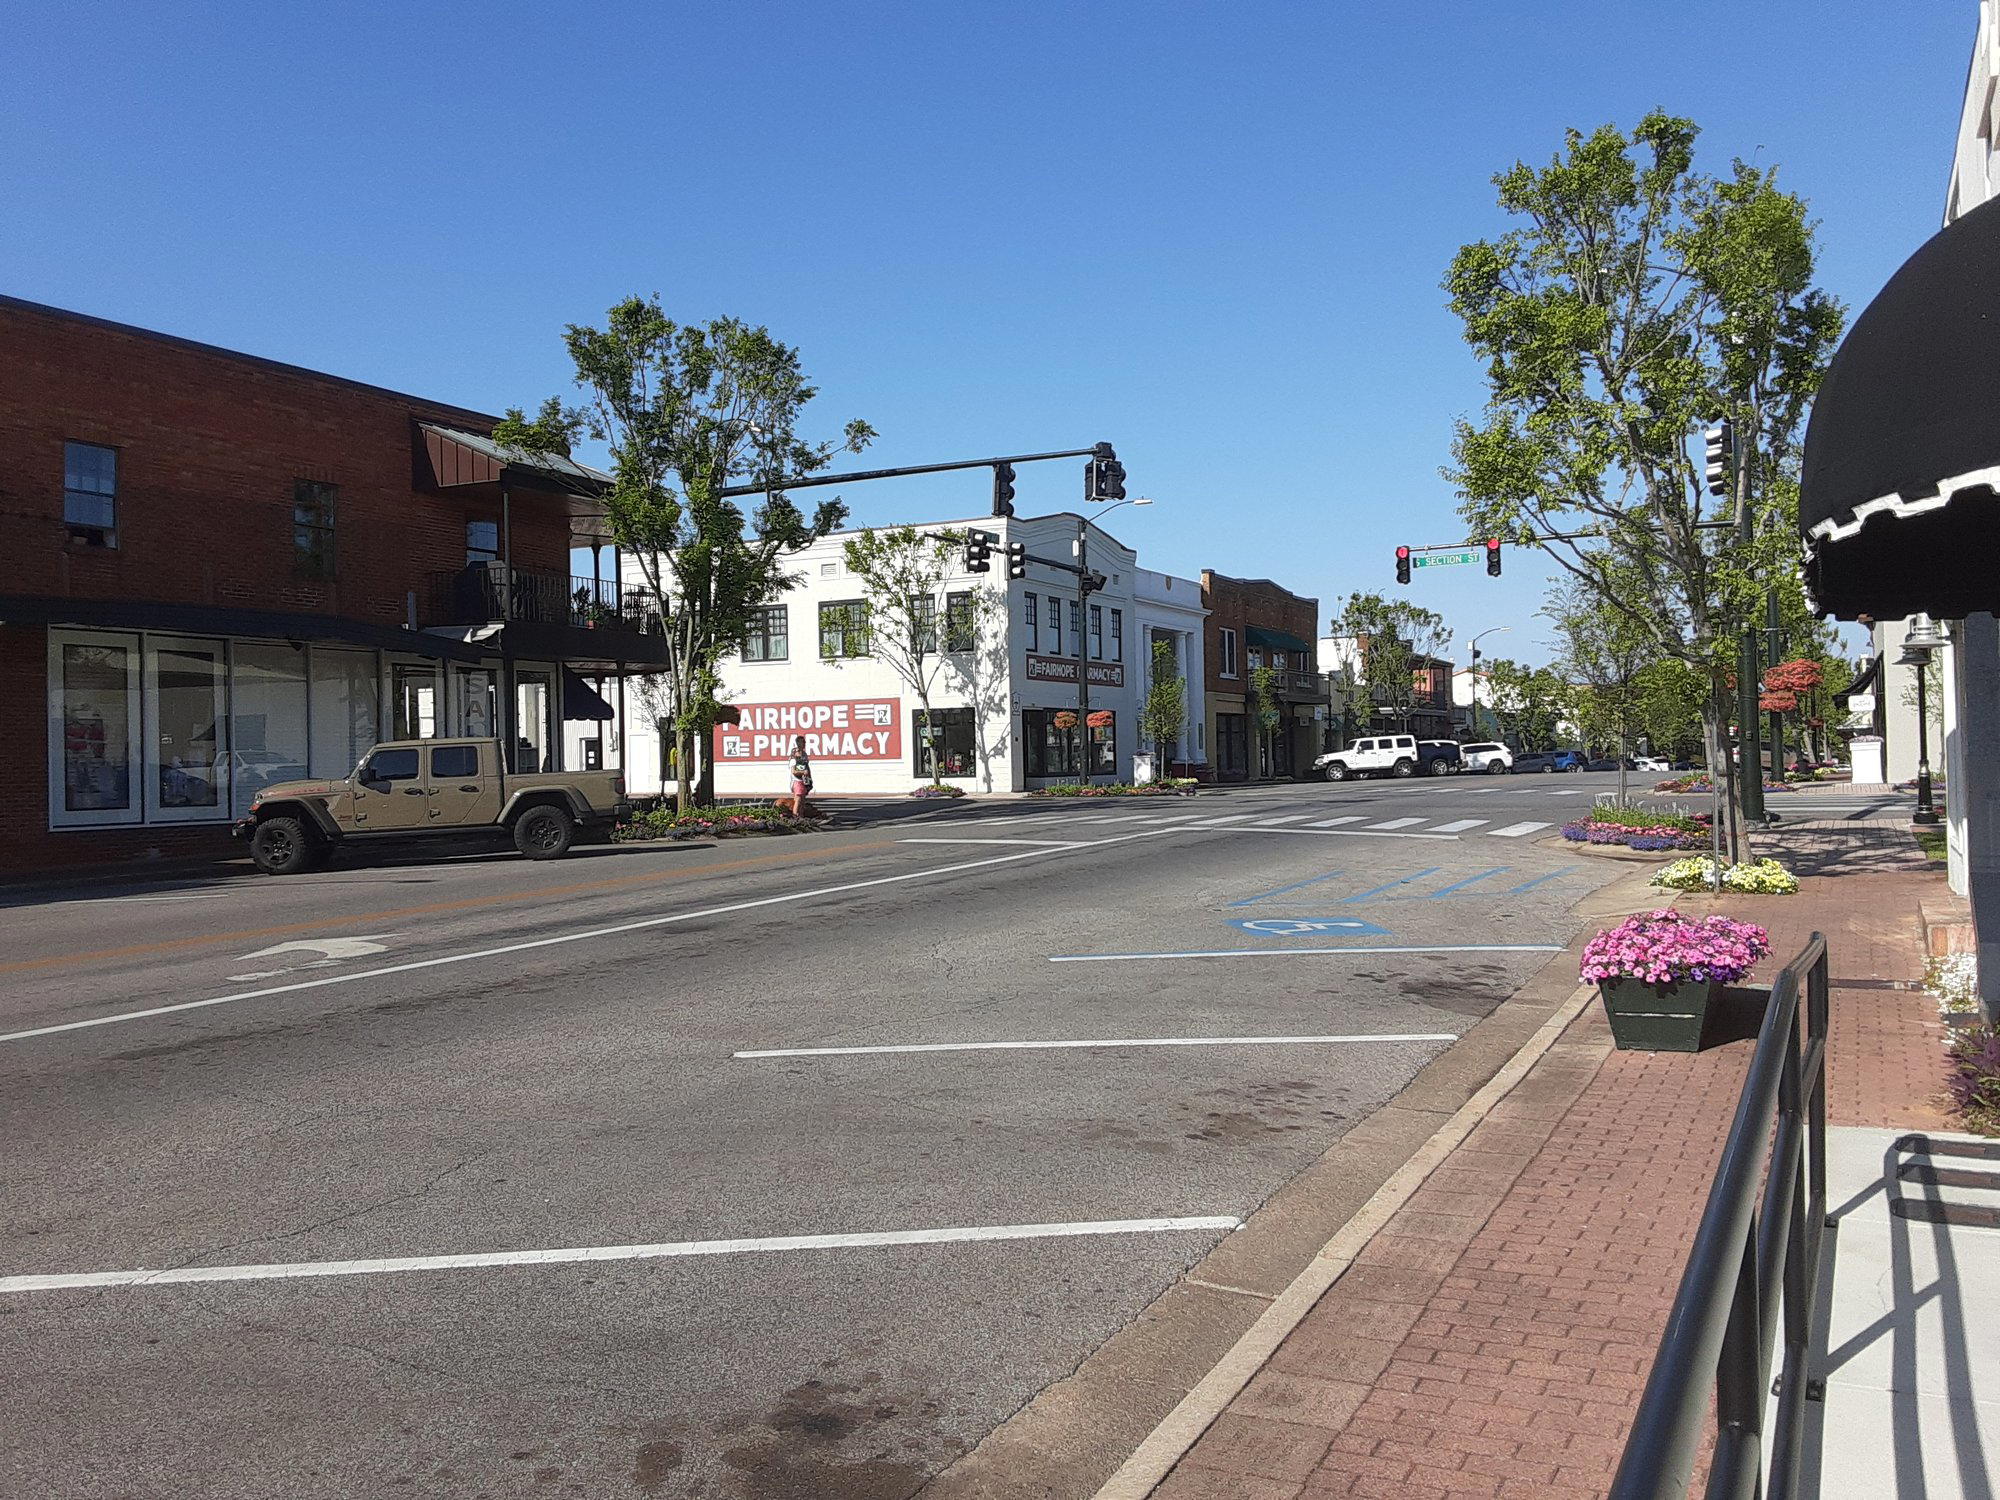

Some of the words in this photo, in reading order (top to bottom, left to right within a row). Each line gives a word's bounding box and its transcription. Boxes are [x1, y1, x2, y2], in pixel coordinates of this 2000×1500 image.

[1425, 555, 1462, 566] SECTION
[1468, 553, 1479, 563] ST
[1041, 662, 1074, 677] FAIRHOPE
[1077, 666, 1110, 681] RMACY
